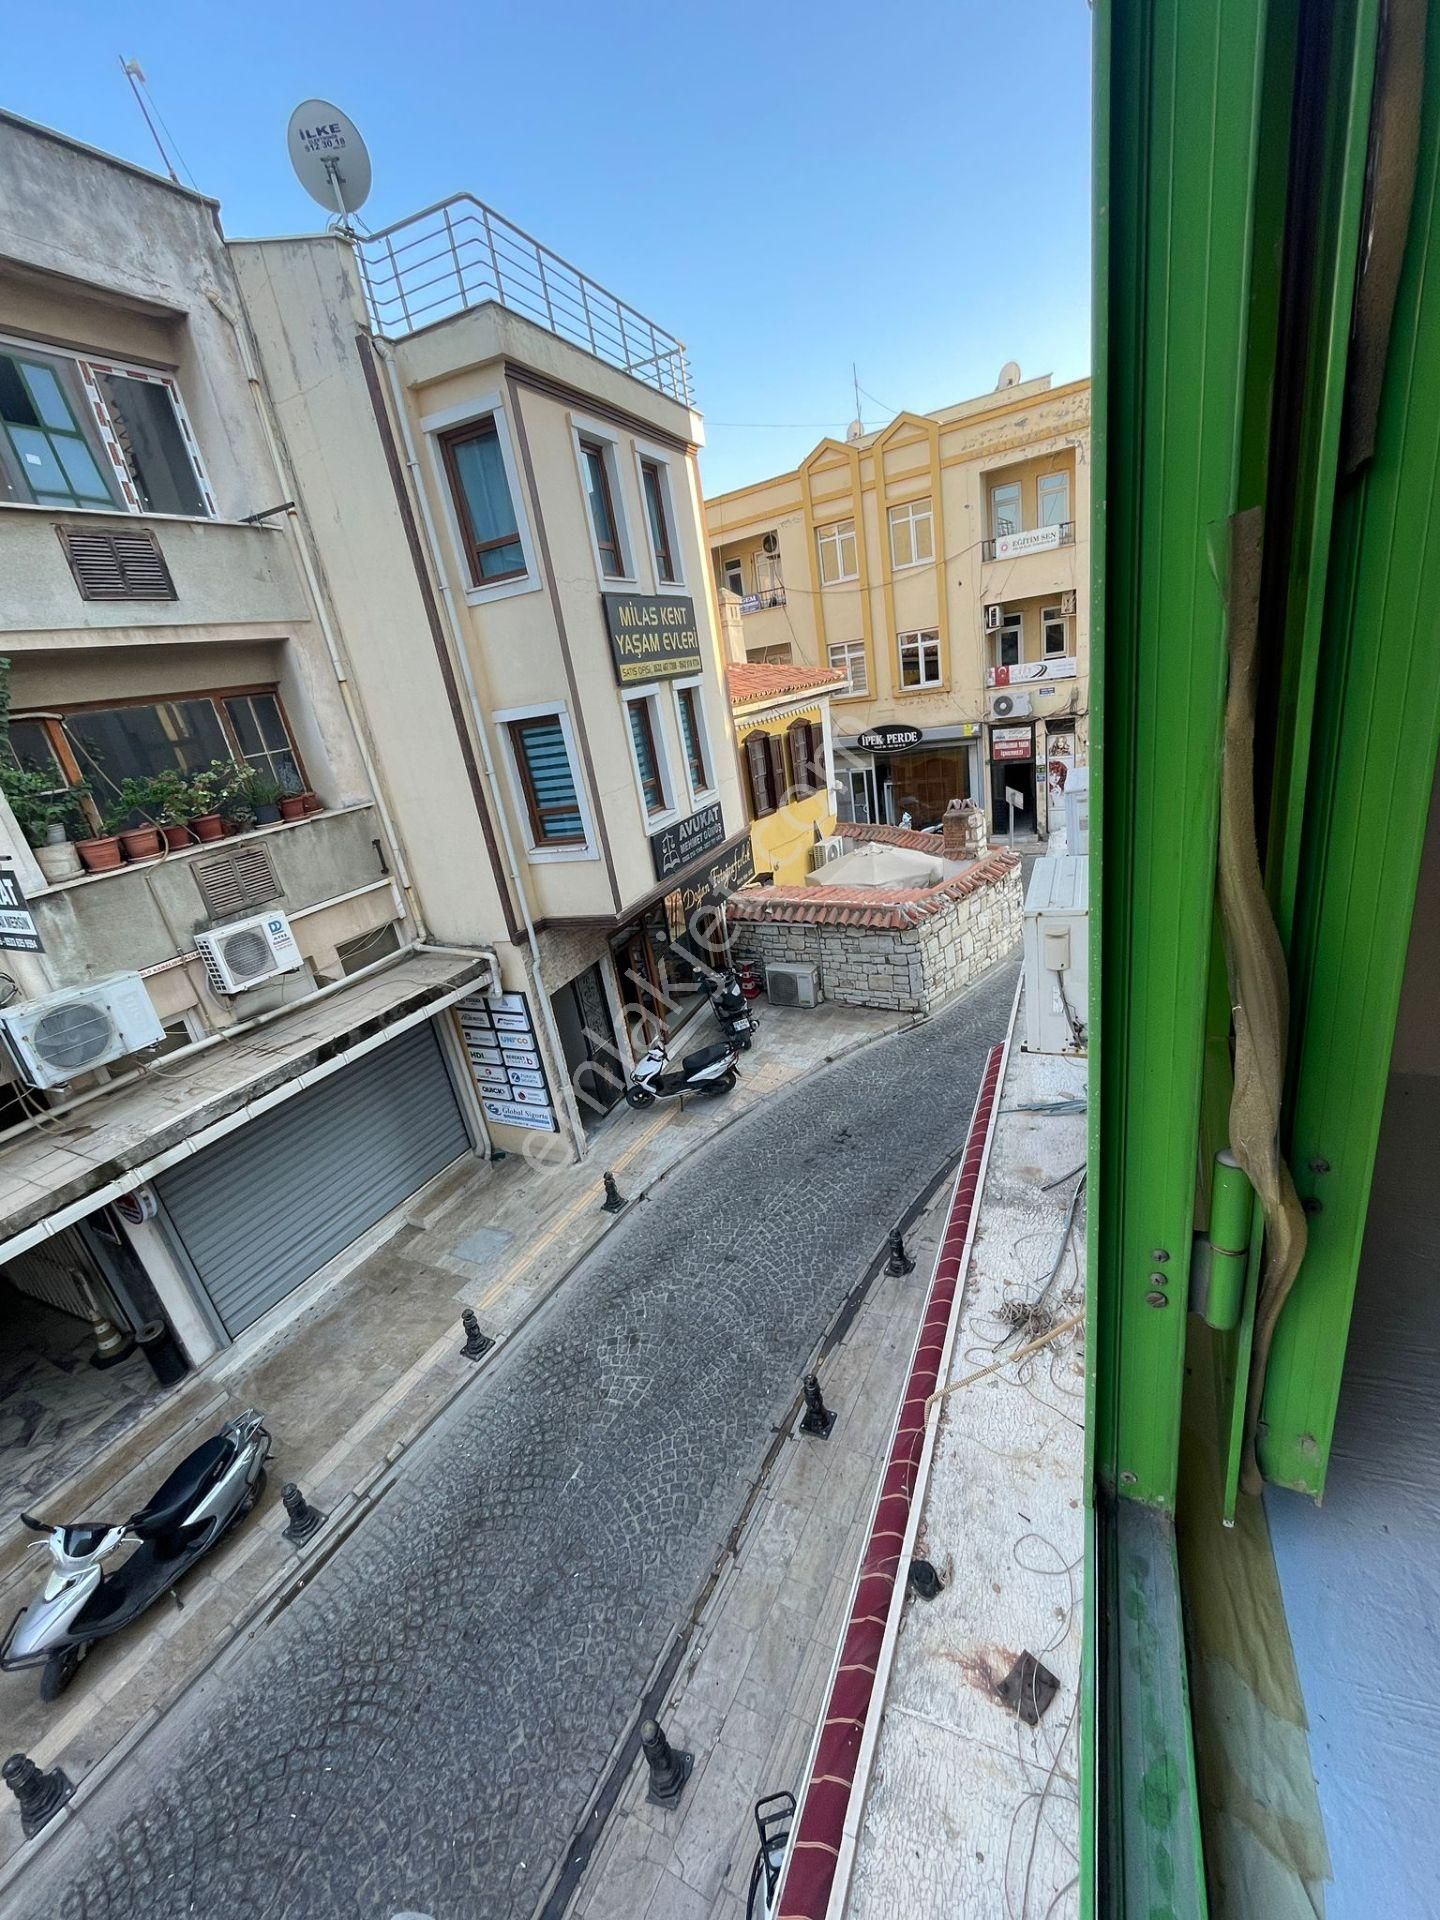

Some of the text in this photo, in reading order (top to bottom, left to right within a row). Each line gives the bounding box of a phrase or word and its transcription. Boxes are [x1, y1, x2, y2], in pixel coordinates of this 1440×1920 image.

[1041, 532, 1056, 540] SEN
[619, 601, 687, 626] MİLAS KENT
[615, 626, 698, 658] YAŞAM EVLERİ
[861, 731, 918, 746] İPEK PERDE
[679, 806, 720, 841] AVUKAT
[0, 878, 19, 906] AT
[470, 1051, 485, 1059] HDI
[502, 1107, 523, 1116] Global
[524, 1110, 548, 1120] Sigorta
